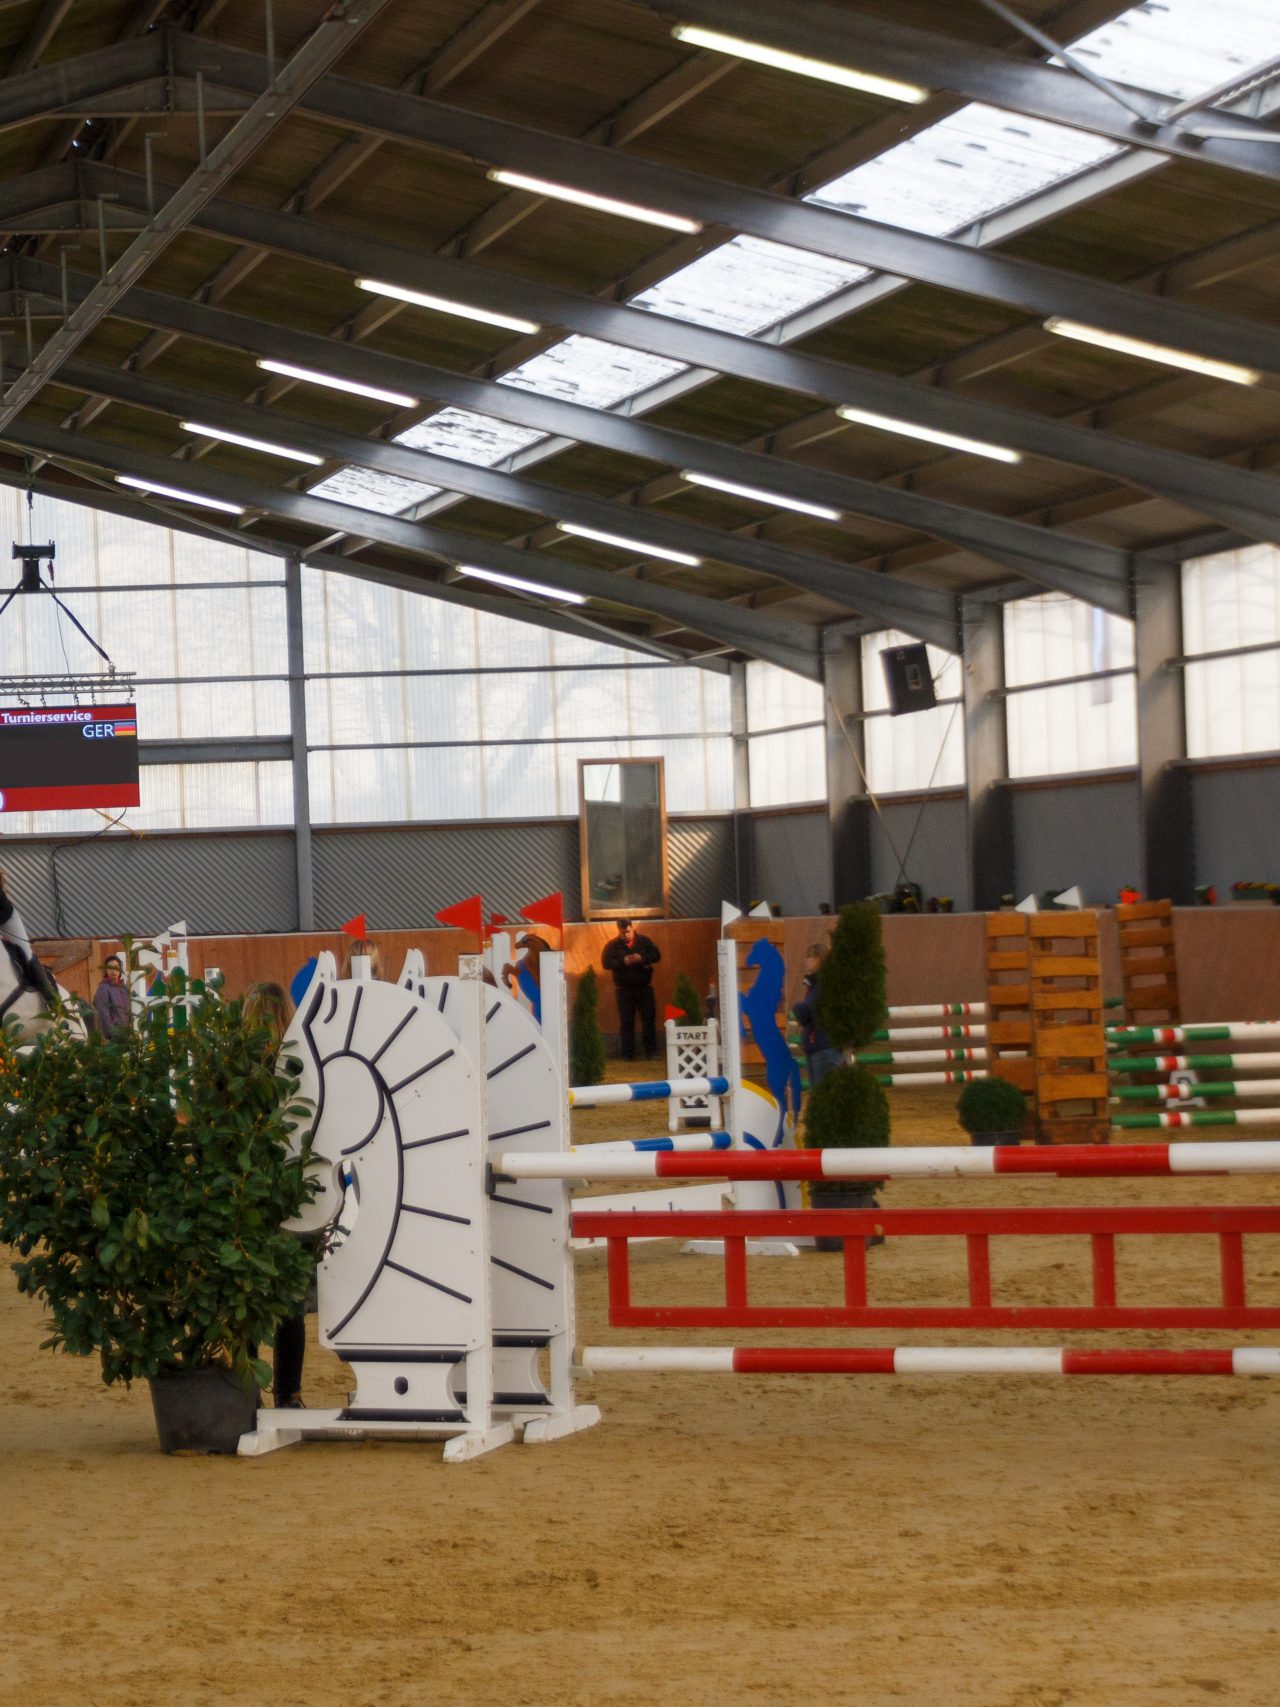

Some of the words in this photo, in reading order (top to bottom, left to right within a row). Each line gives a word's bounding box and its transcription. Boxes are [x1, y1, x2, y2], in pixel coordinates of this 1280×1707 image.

[1, 710, 92, 724] Turnierservice
[82, 724, 114, 738] GER
[676, 1031, 708, 1040] START
